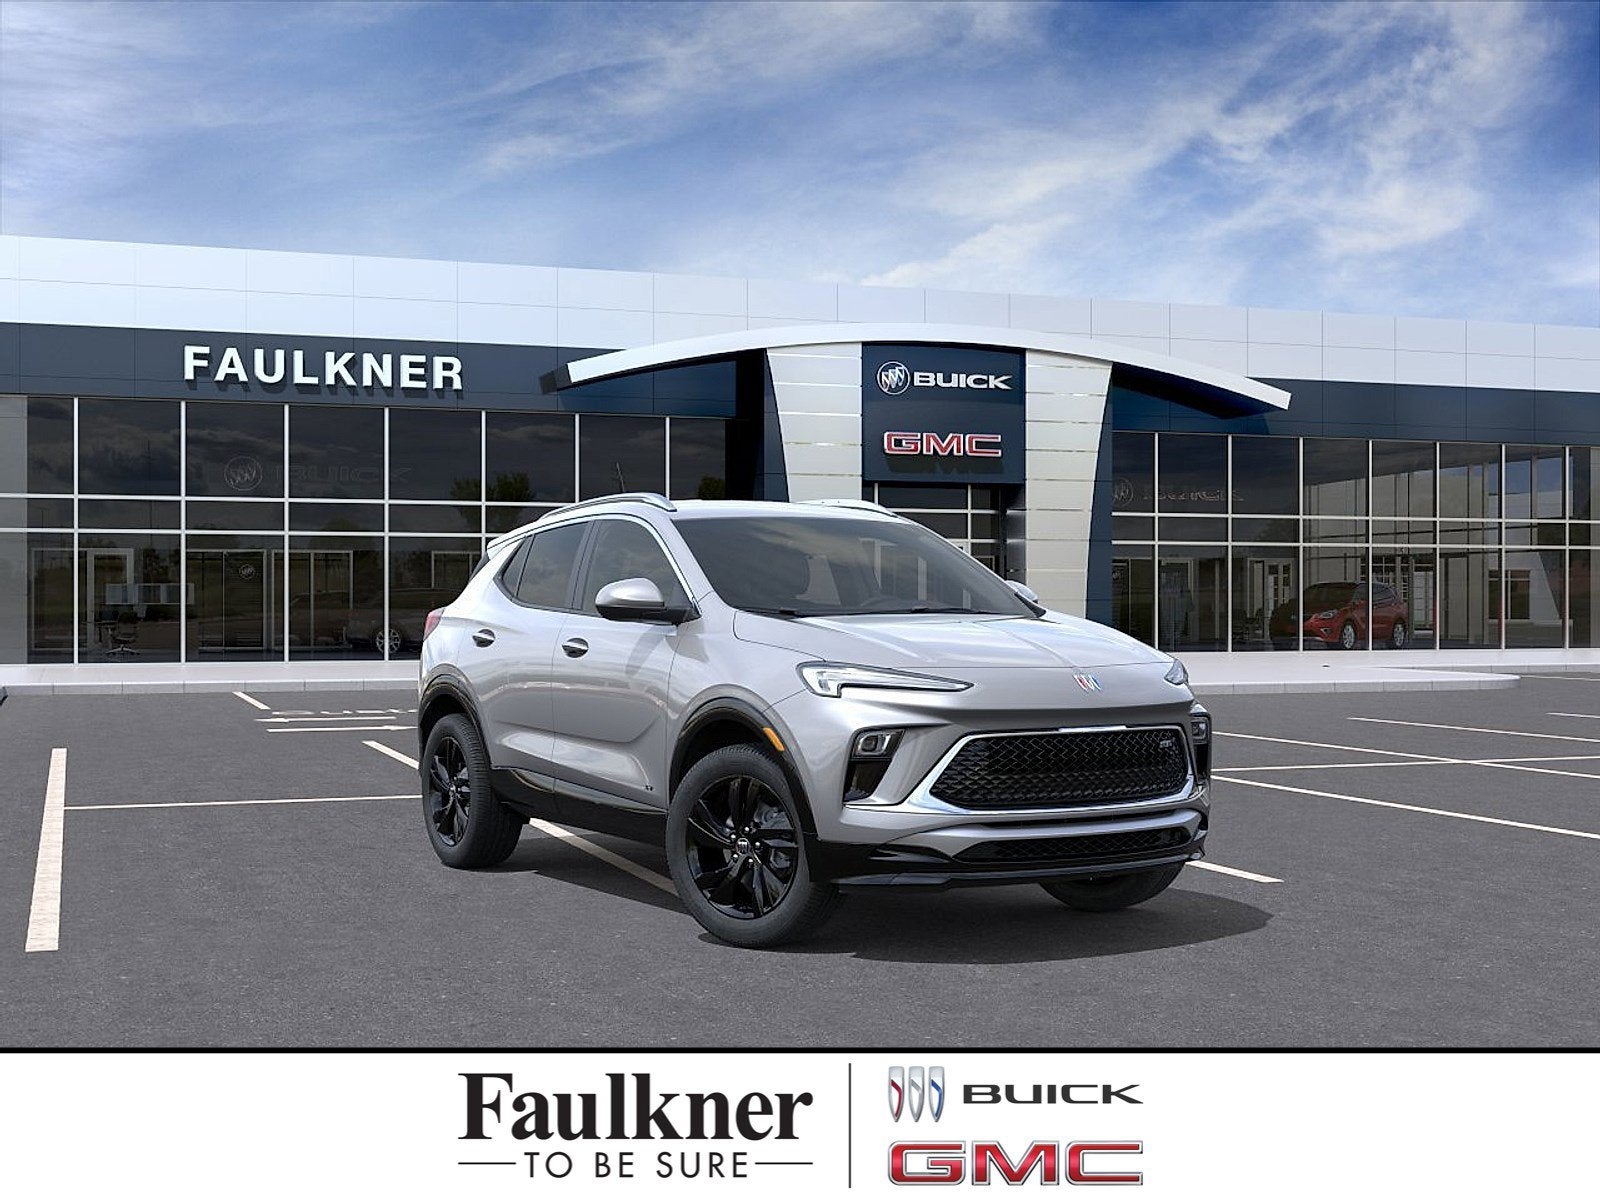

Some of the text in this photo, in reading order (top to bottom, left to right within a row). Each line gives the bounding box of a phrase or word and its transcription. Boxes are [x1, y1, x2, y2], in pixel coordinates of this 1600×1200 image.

[184, 345, 463, 390] FAULKNER
[913, 372, 1013, 390] BUICK
[884, 431, 1002, 458] GMC
